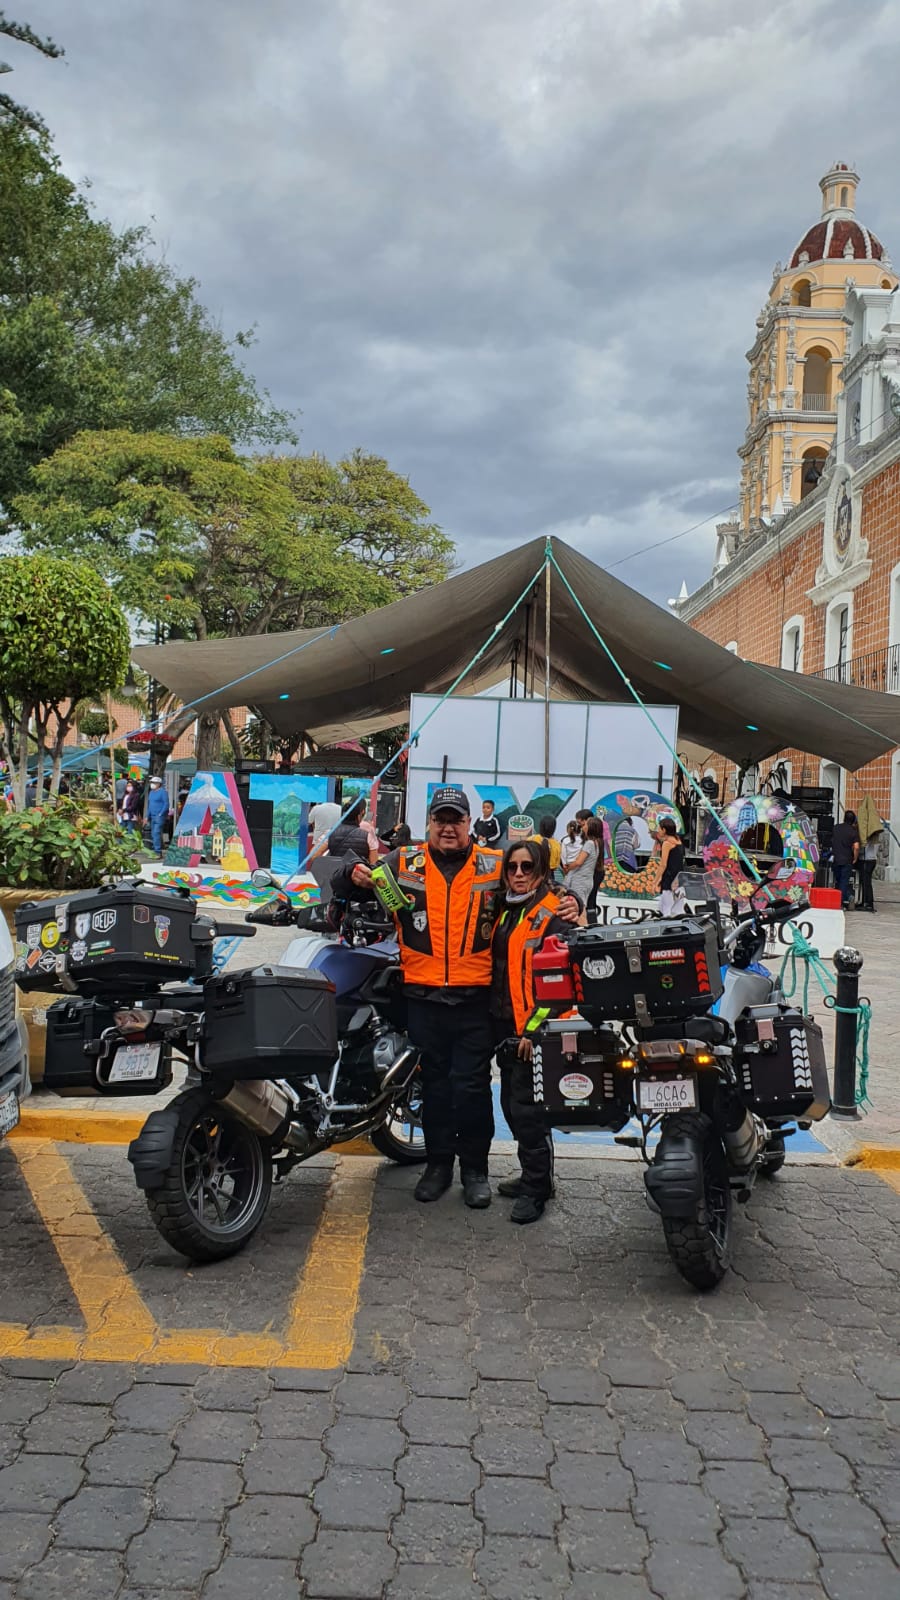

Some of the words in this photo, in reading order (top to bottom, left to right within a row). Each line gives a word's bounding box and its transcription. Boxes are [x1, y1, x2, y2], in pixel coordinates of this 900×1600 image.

[94, 912, 114, 929] DEUS
[651, 949, 684, 959] MOTUL
[647, 1085, 687, 1103] L6CA6
